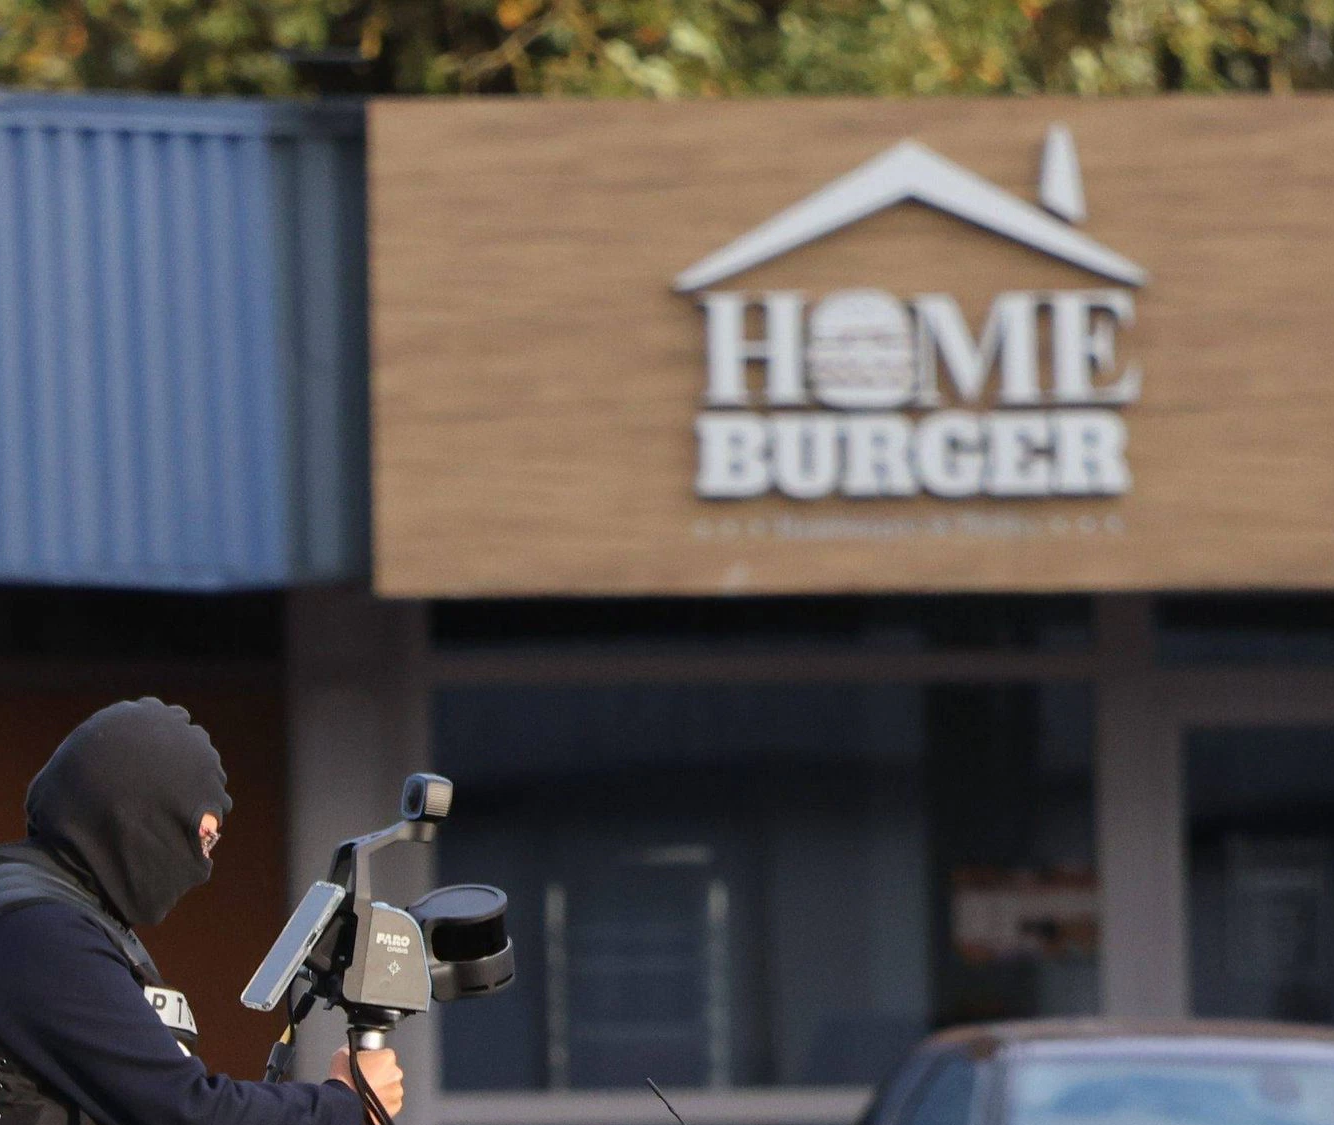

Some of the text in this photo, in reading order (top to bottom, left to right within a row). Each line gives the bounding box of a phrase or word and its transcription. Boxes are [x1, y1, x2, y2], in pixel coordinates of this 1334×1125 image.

[697, 286, 1143, 411] HOME
[694, 411, 1130, 499] BURGER
[375, 932, 411, 948] FARO
